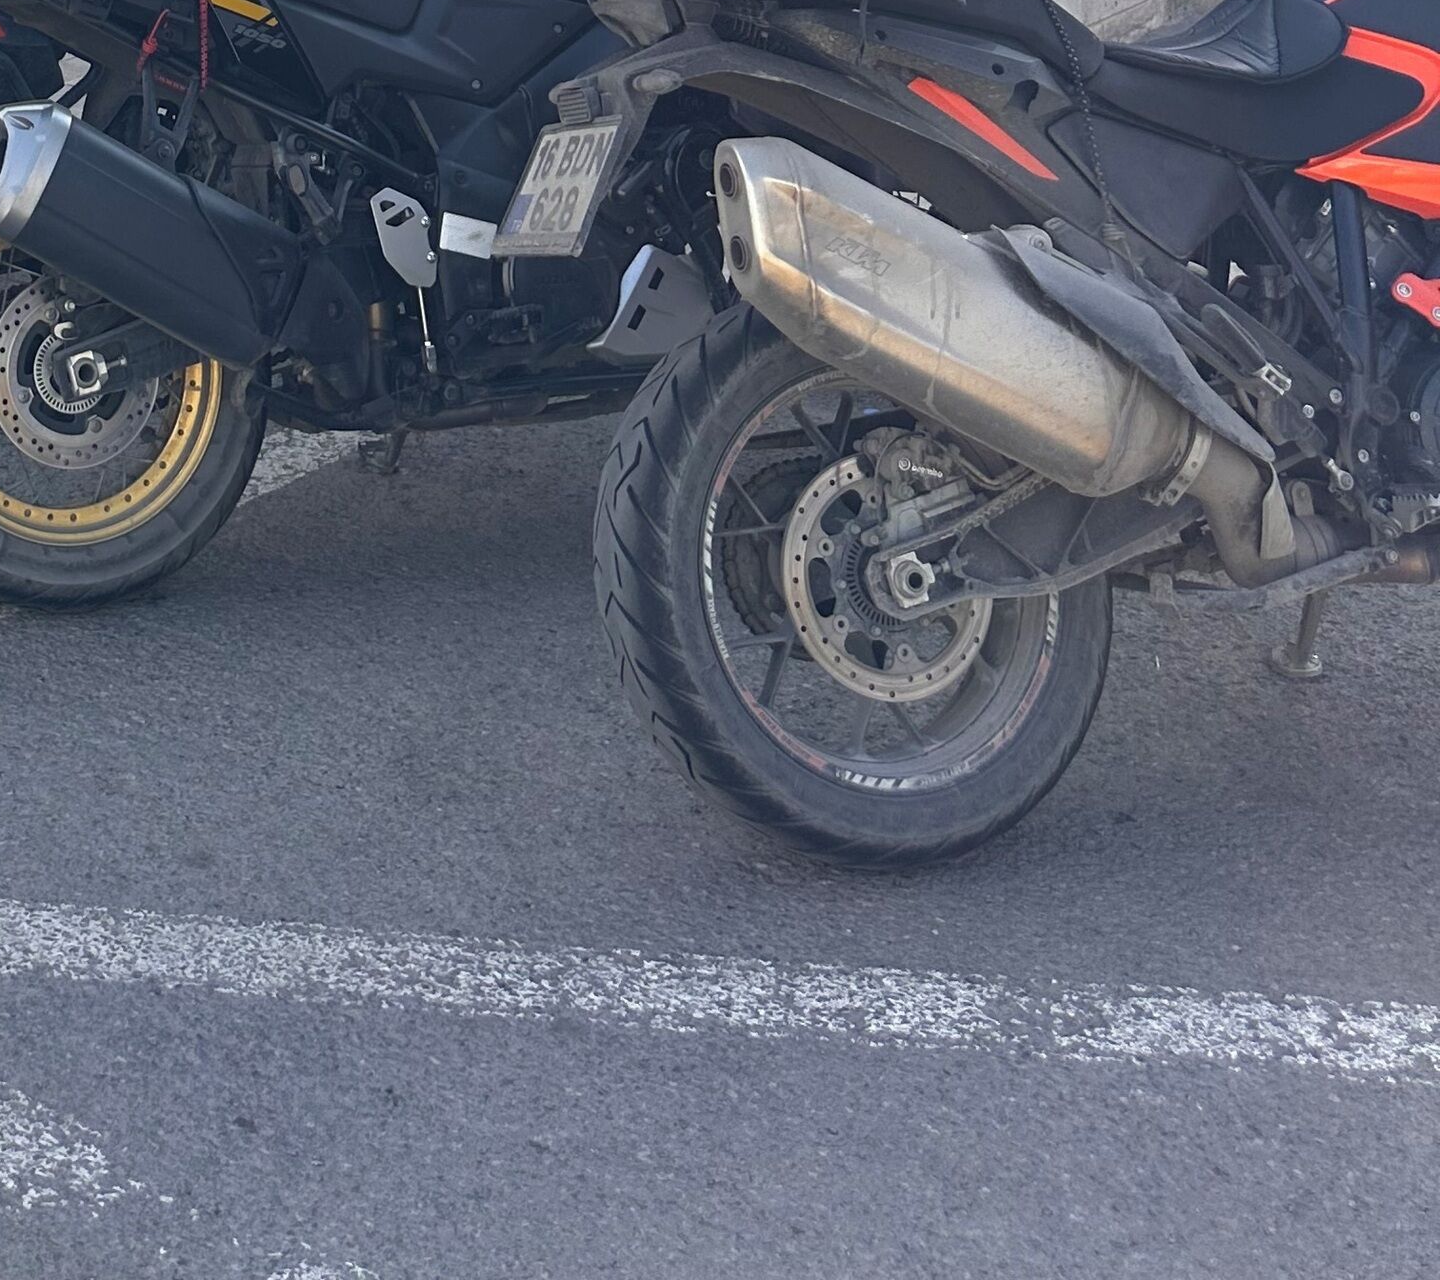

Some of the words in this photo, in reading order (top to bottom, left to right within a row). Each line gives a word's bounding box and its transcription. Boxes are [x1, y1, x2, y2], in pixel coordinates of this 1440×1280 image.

[234, 24, 287, 49] 1050
[532, 138, 561, 182] 16
[555, 131, 614, 180] BDN
[529, 186, 580, 232] 628
[825, 236, 892, 277] KTM
